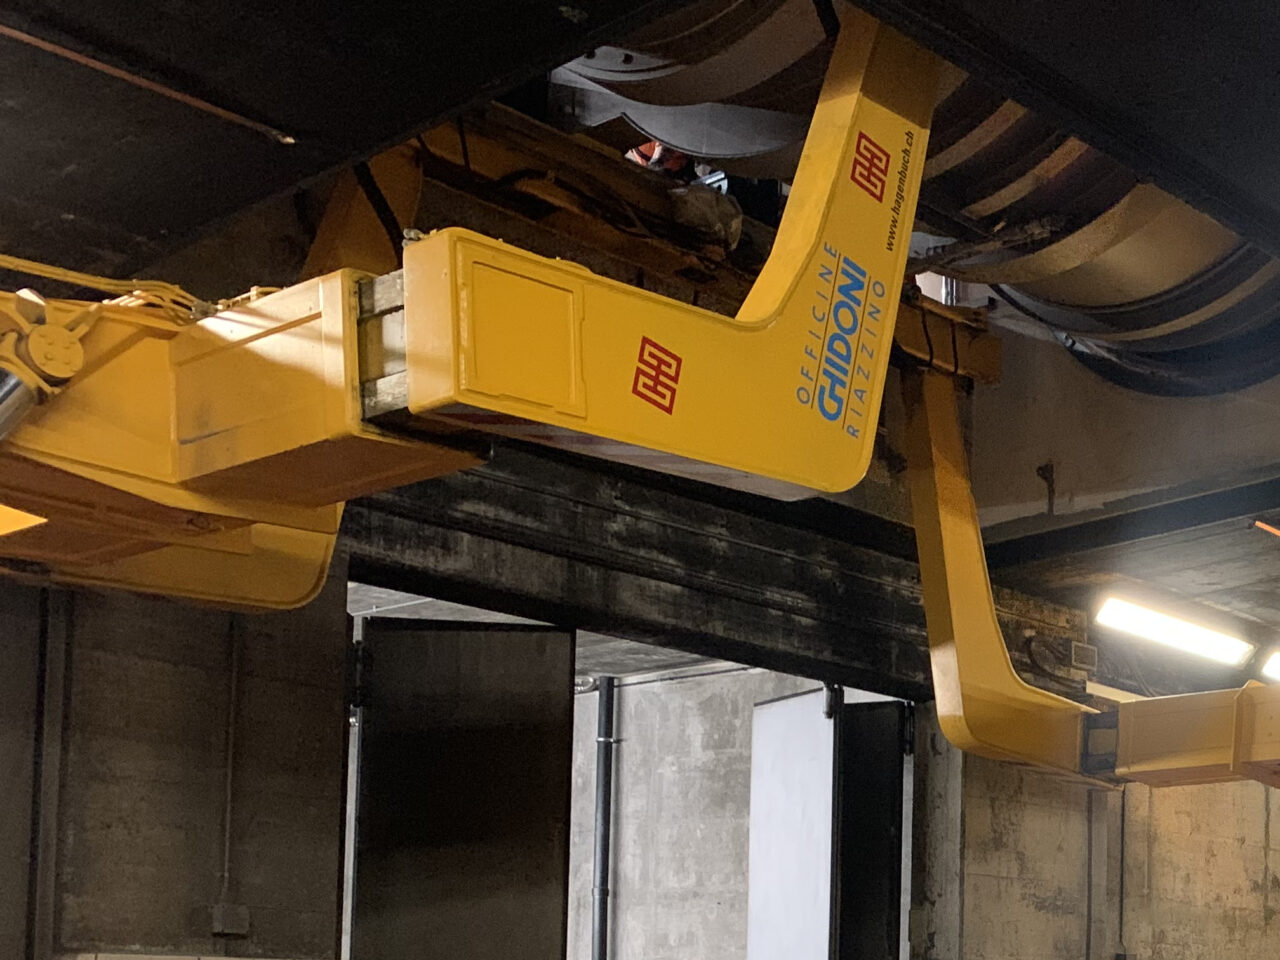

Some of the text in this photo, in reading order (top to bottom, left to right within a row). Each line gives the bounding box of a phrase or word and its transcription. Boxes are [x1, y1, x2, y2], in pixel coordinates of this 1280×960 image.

[886, 130, 914, 252] www.hagenbuch.ch
[797, 241, 841, 405] OFFICINE
[817, 257, 871, 422] GHIDONI
[846, 280, 887, 439] RIAZZINO
